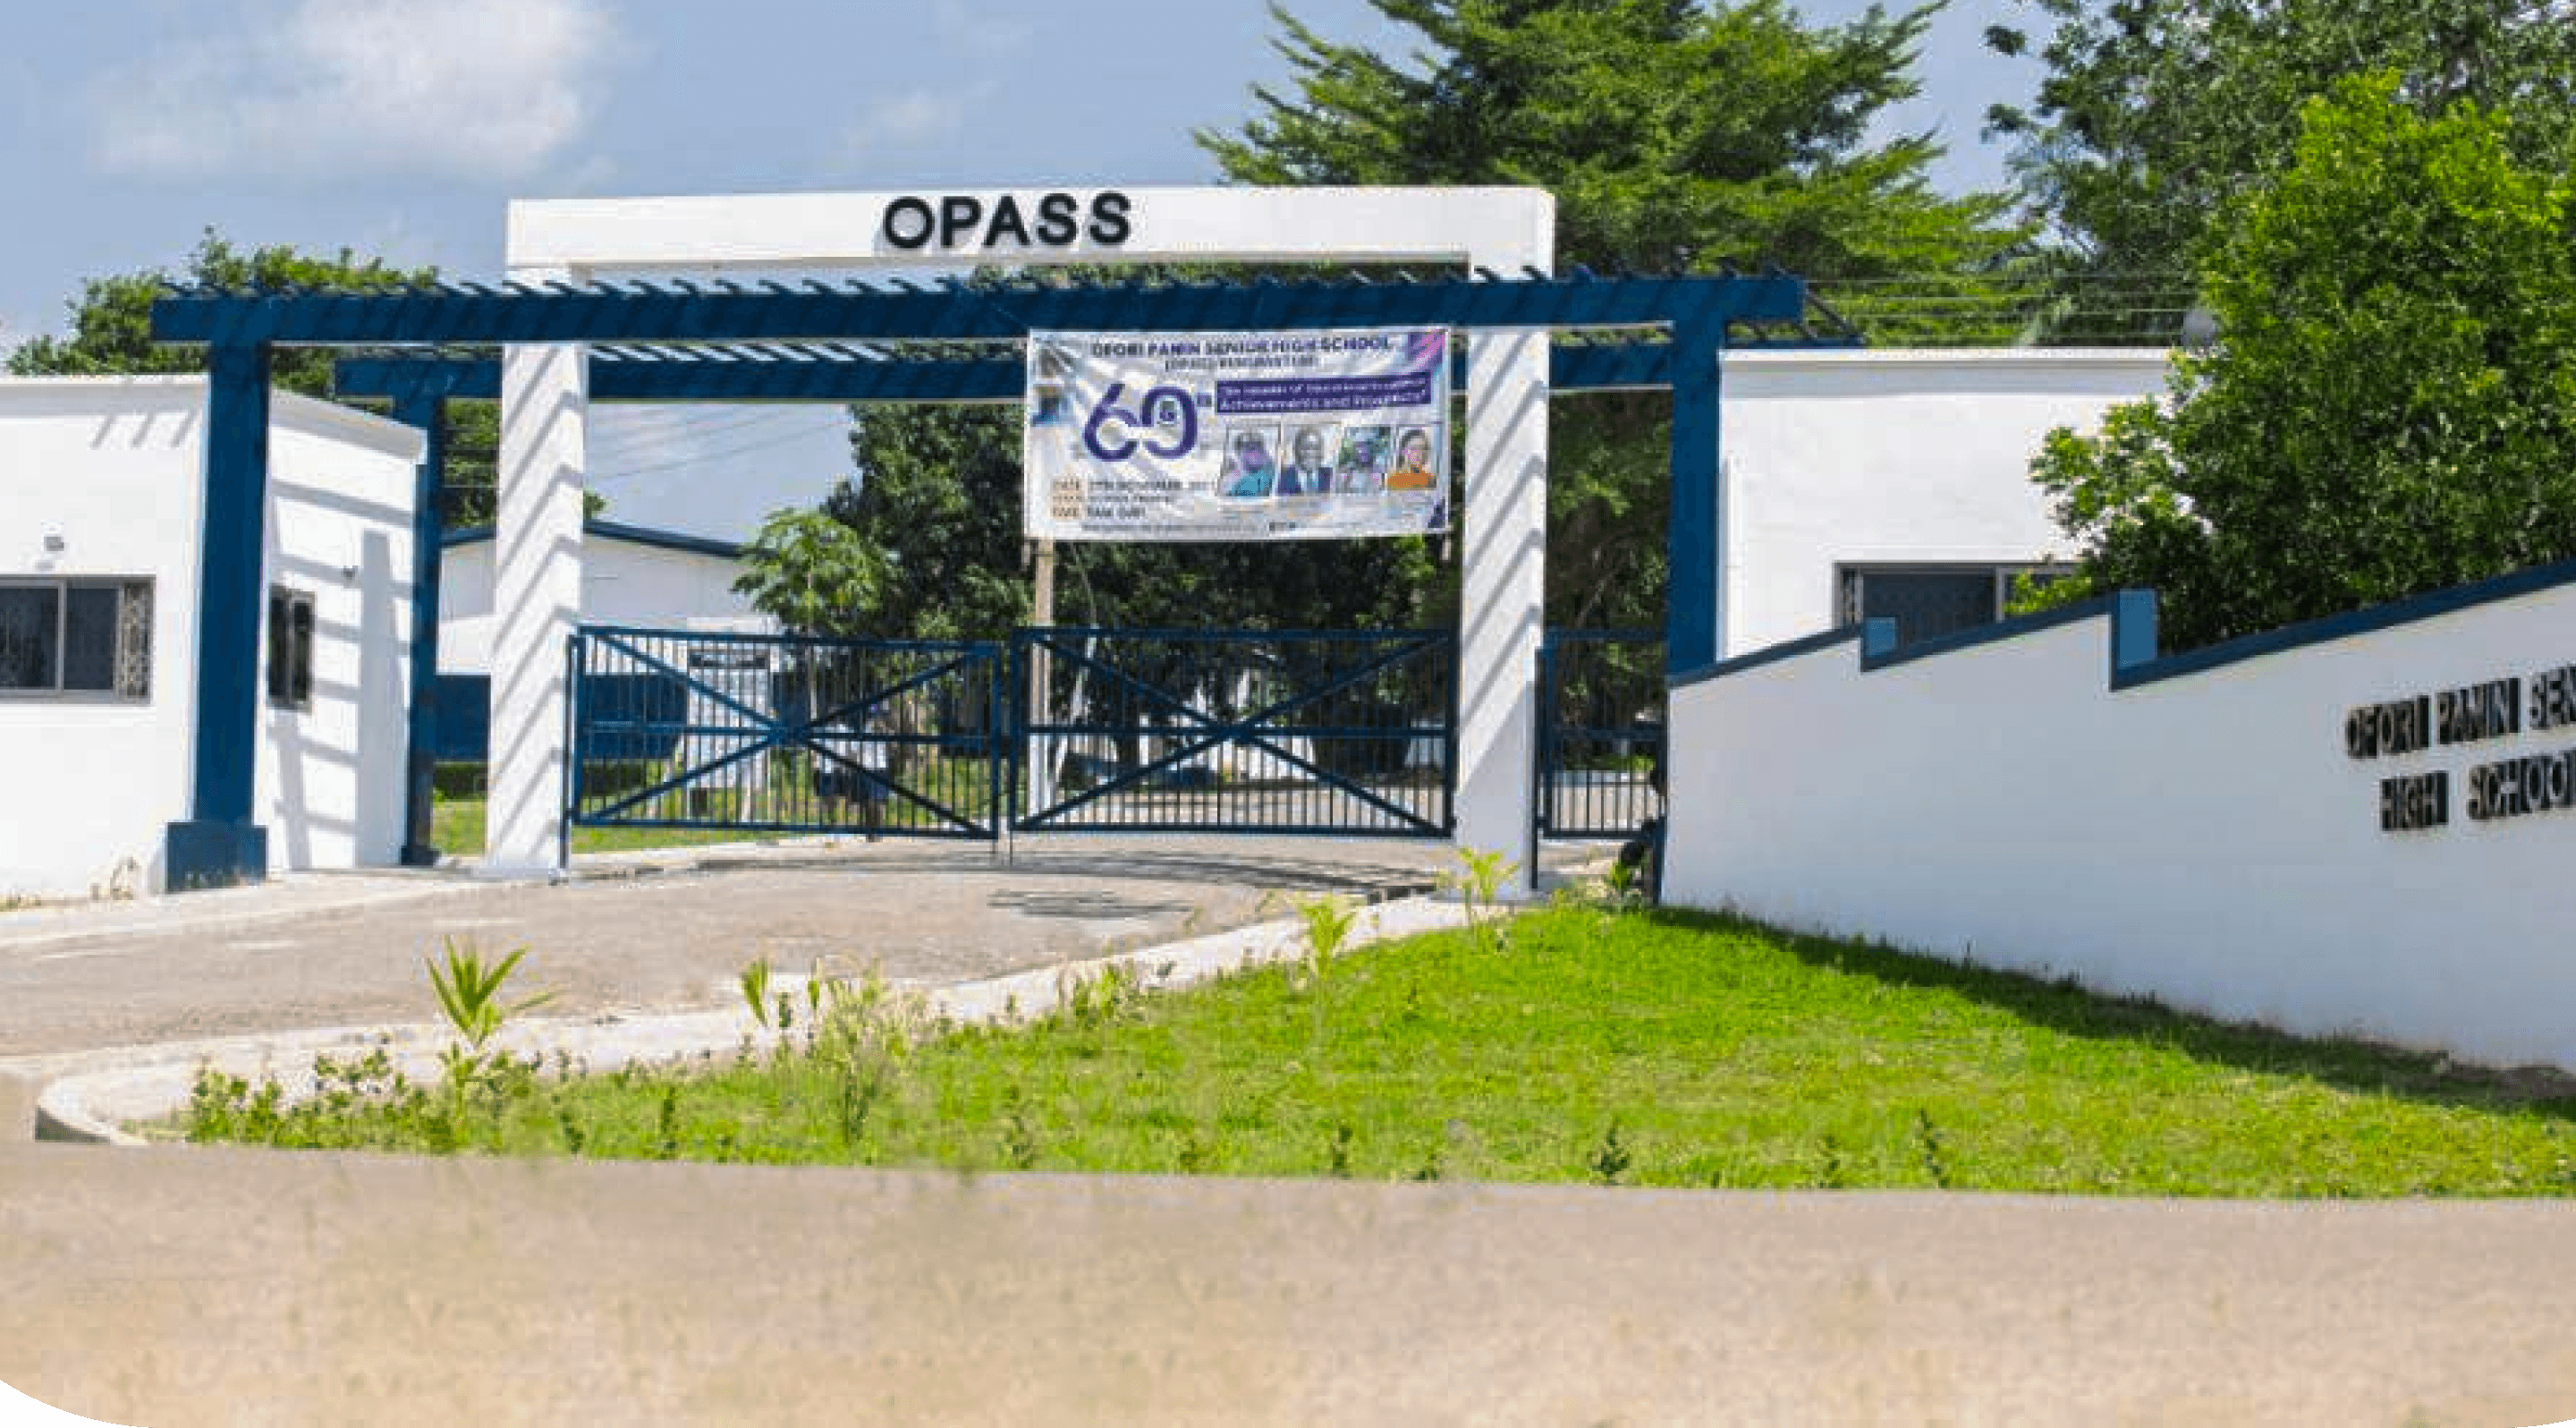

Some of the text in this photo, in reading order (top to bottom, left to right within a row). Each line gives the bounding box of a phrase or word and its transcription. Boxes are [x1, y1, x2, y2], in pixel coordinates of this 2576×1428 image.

[881, 191, 1131, 249] OPASS
[1091, 342, 1143, 357] OFORI
[1148, 342, 1200, 356] PANIN
[1320, 336, 1389, 352] SCHOOL
[2344, 694, 2429, 760] OFORI
[2435, 677, 2521, 745] PANIN
[2379, 770, 2449, 831] HIGH
